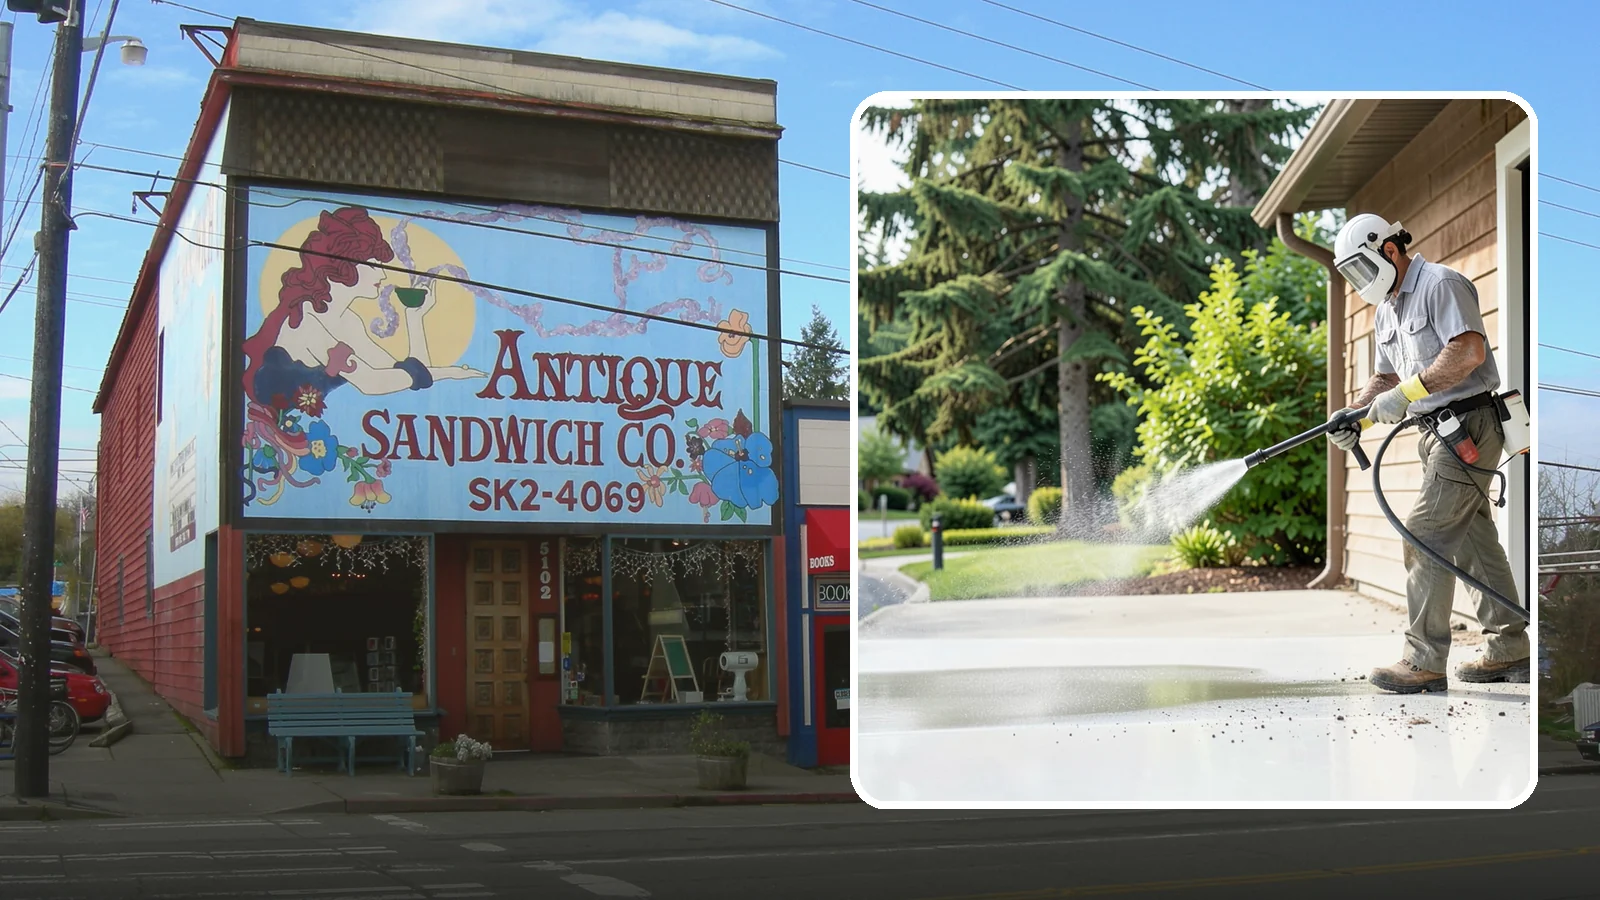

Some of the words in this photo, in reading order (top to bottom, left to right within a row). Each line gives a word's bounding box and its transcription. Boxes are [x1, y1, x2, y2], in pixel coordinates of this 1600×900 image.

[476, 329, 723, 421] ANTIQUE
[361, 408, 604, 467] SANDWICH
[617, 422, 684, 469] CO.
[468, 476, 646, 513] SK2-4069
[539, 541, 551, 600] 5102
[809, 556, 834, 568] BOOKS
